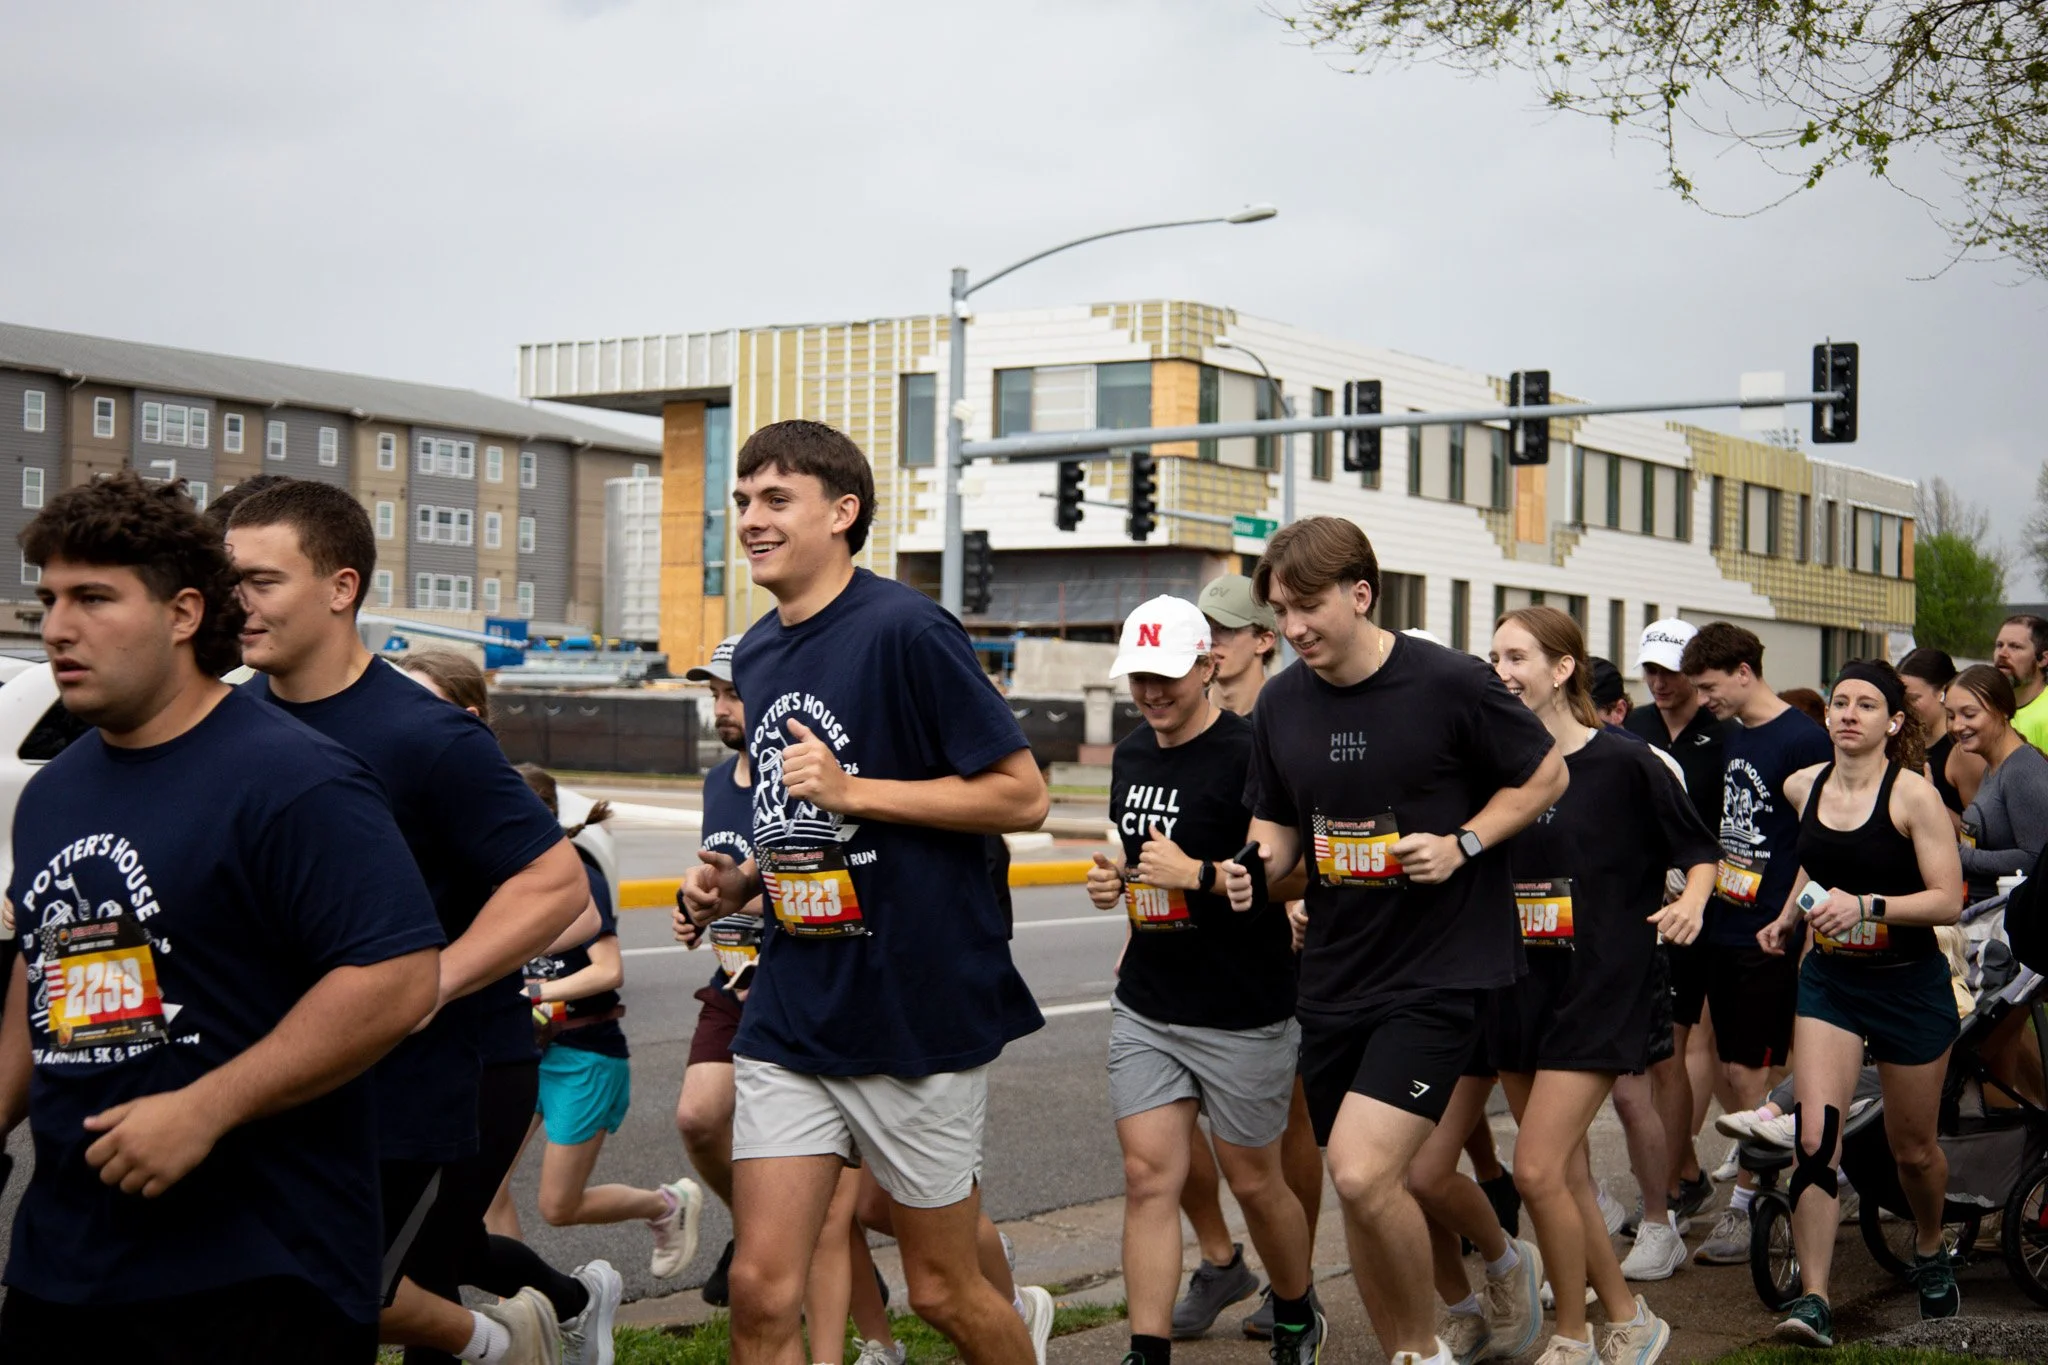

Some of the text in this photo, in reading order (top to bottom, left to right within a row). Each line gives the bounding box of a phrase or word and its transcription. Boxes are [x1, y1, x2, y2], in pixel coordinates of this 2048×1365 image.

[1136, 623, 1162, 647] N
[750, 691, 850, 758] POTTER'S HOUSE
[1330, 731, 1367, 747] HILL
[843, 763, 859, 774] 26
[1329, 747, 1367, 762] CITY
[1744, 762, 1771, 799] HOUSE
[1125, 784, 1180, 813] HILL
[1121, 812, 1177, 840] CITY
[850, 849, 878, 866] RUN
[1334, 841, 1386, 873] 2165
[1755, 850, 1771, 859] RUN
[23, 833, 160, 922] POTTER'S HOUSE
[780, 878, 843, 917] 2223
[1134, 887, 1170, 917] 2118
[94, 1046, 112, 1063] 5K
[114, 1046, 125, 1063] &
